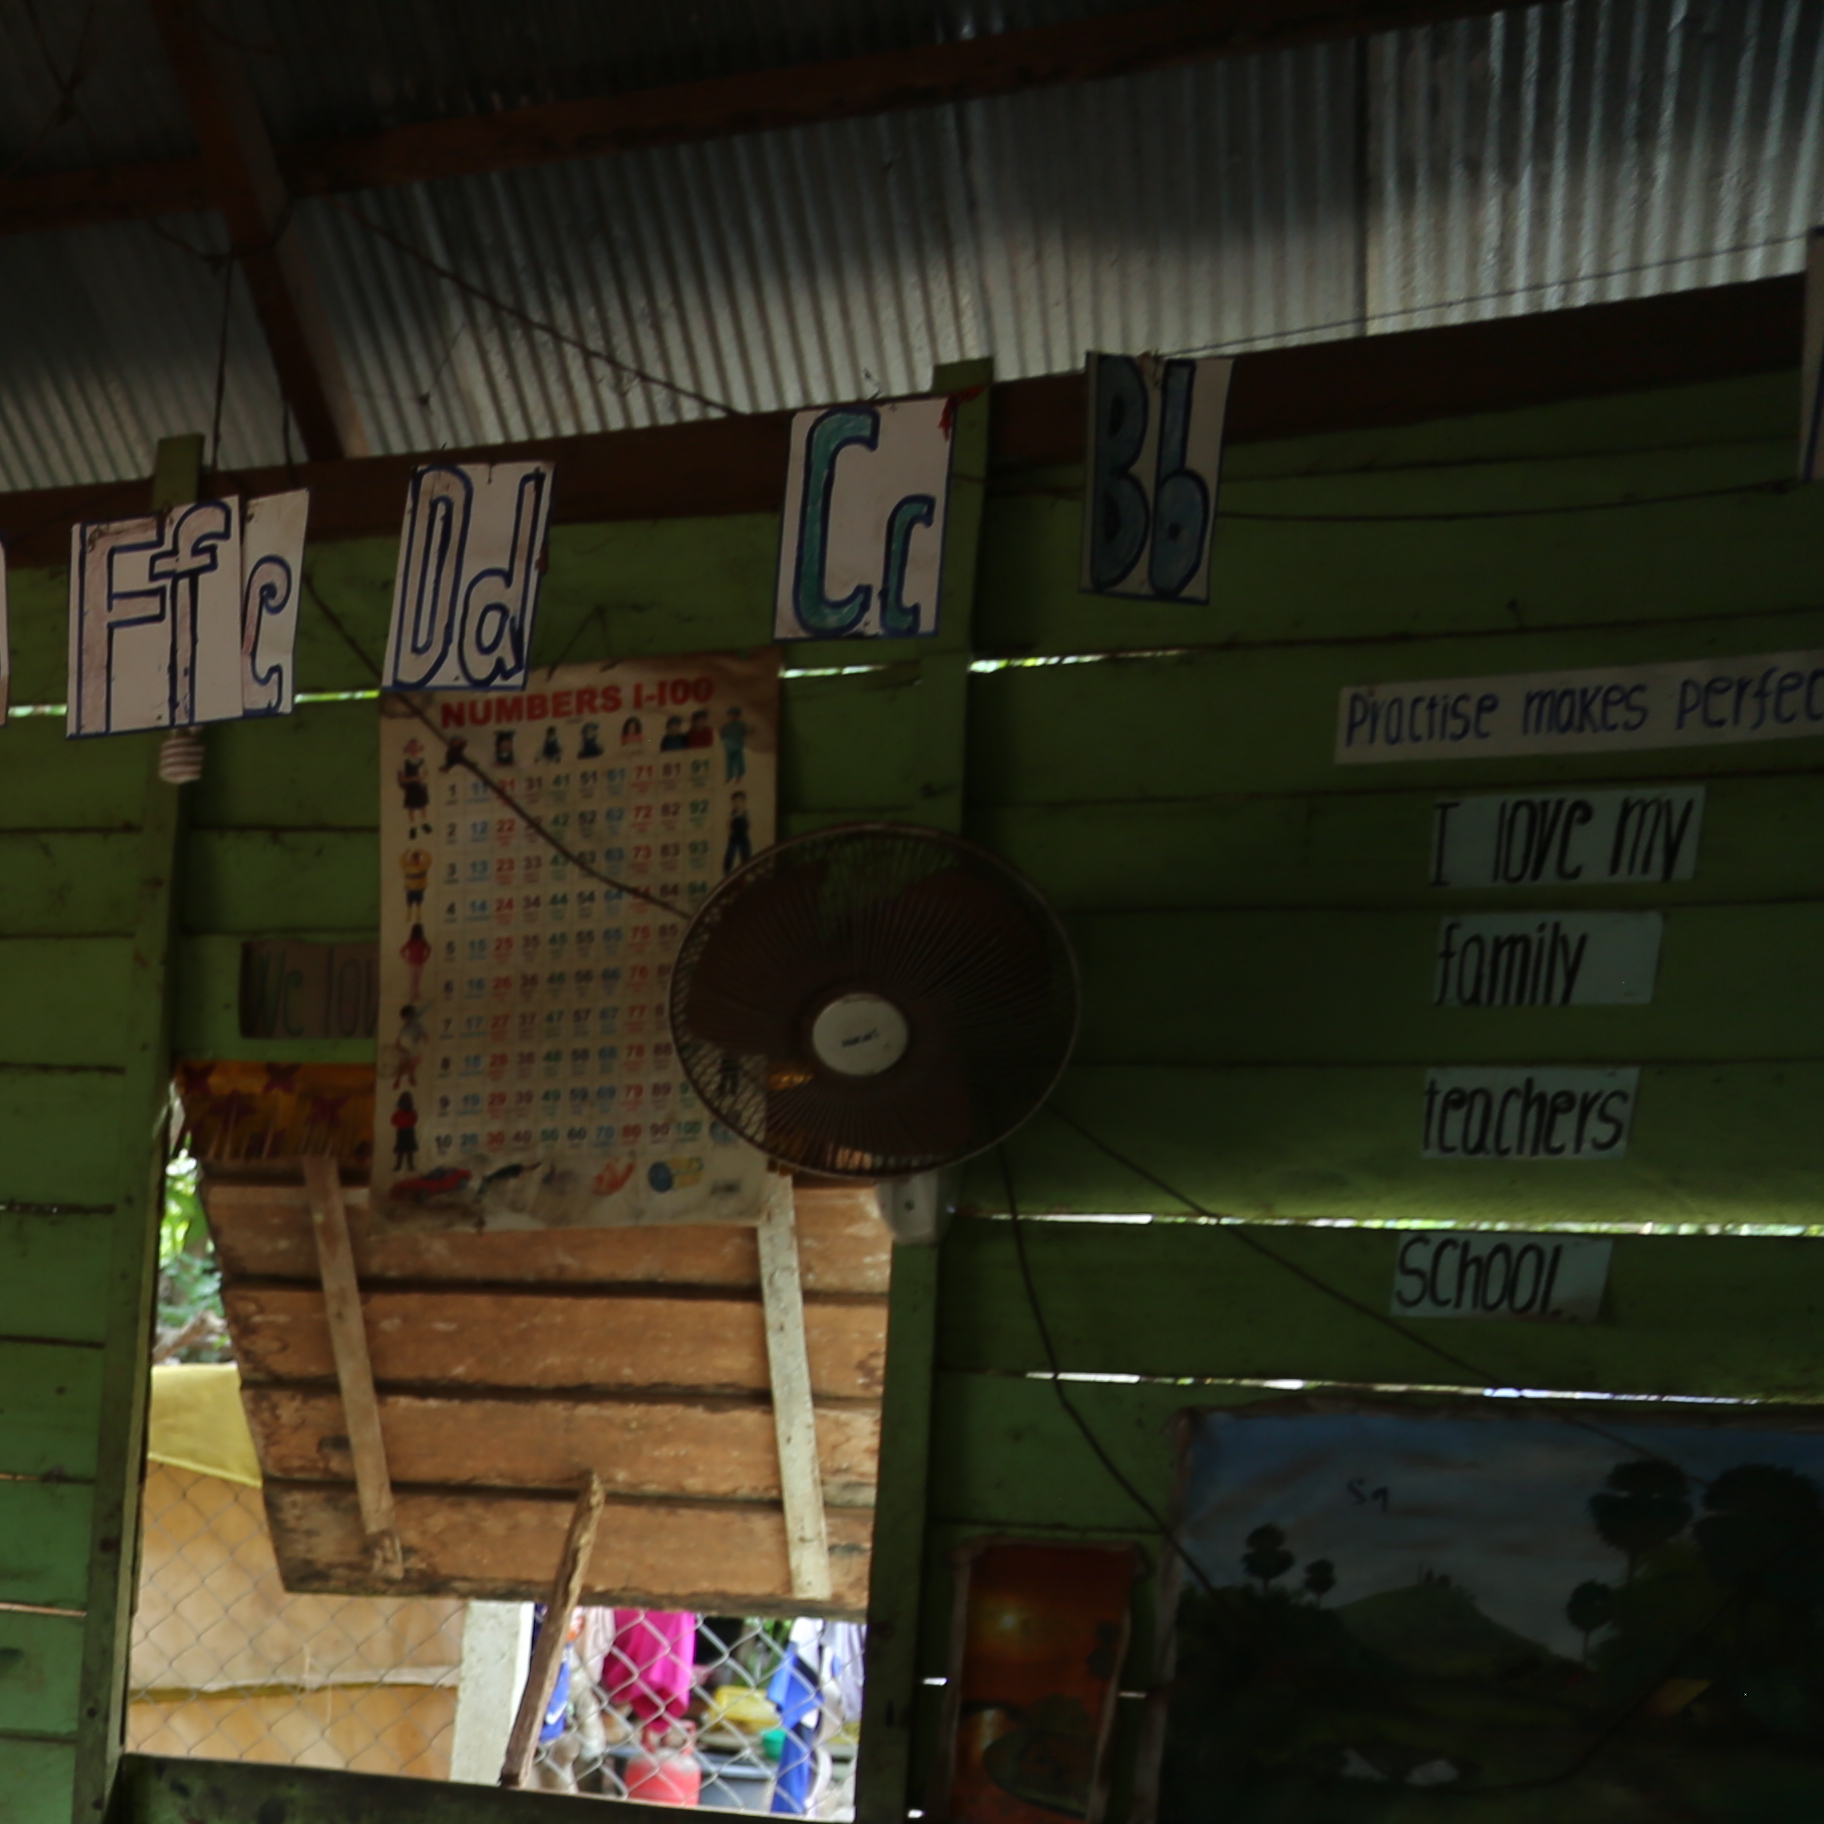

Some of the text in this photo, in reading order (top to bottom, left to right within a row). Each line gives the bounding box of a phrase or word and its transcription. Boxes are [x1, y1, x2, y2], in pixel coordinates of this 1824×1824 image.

[1088, 354, 1210, 598] Bb
[793, 407, 934, 637] Cc
[78, 500, 231, 735] Ff
[395, 465, 547, 684] Dd
[441, 684, 622, 729] NUMBERS
[1345, 687, 1499, 746] Practise
[1521, 680, 1648, 736] makes
[1429, 796, 1695, 887] I love my
[1433, 922, 1588, 1007] family
[1422, 1075, 1629, 1157] teachers
